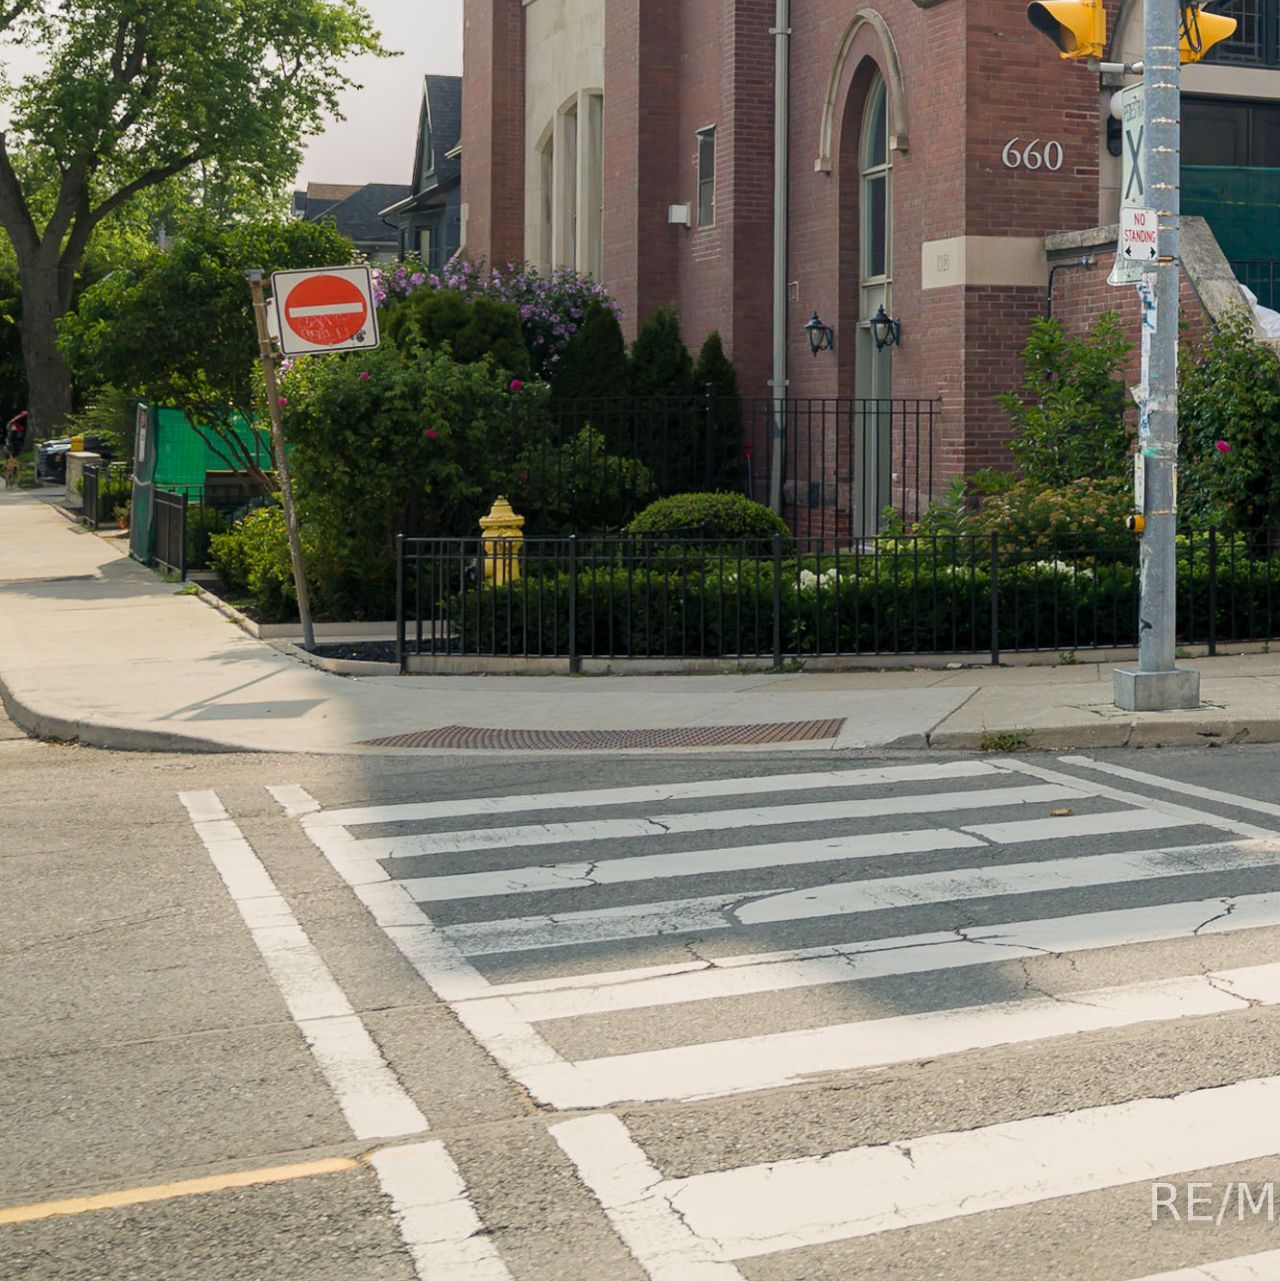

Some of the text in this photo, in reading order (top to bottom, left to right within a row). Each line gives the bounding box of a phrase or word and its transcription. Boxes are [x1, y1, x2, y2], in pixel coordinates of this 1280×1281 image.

[1002, 136, 1063, 171] 660
[1133, 213, 1146, 226] NO
[1124, 229, 1157, 244] STANDING
